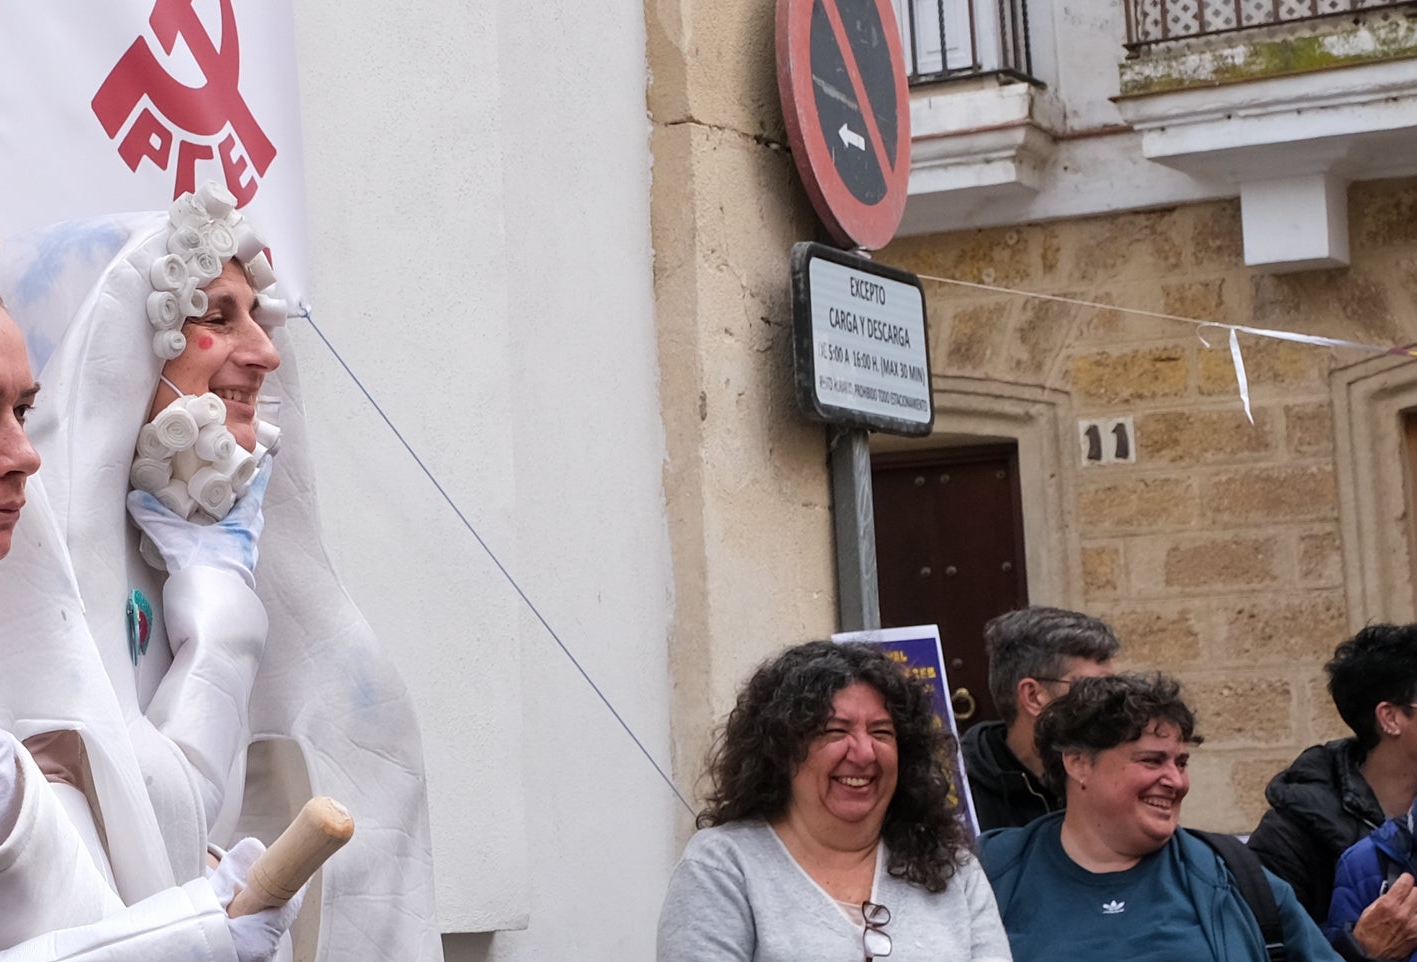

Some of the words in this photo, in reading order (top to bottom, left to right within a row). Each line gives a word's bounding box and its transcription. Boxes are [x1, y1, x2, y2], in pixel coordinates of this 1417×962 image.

[850, 277, 886, 305] EXCEPTO
[829, 307, 858, 334] CARGA
[860, 317, 866, 336] Y
[867, 318, 911, 349] DESCARGA
[845, 348, 850, 365] A
[881, 357, 900, 379] (MAX
[900, 364, 909, 380] 30
[909, 366, 926, 387] MIN)
[1085, 423, 1130, 461] 11
